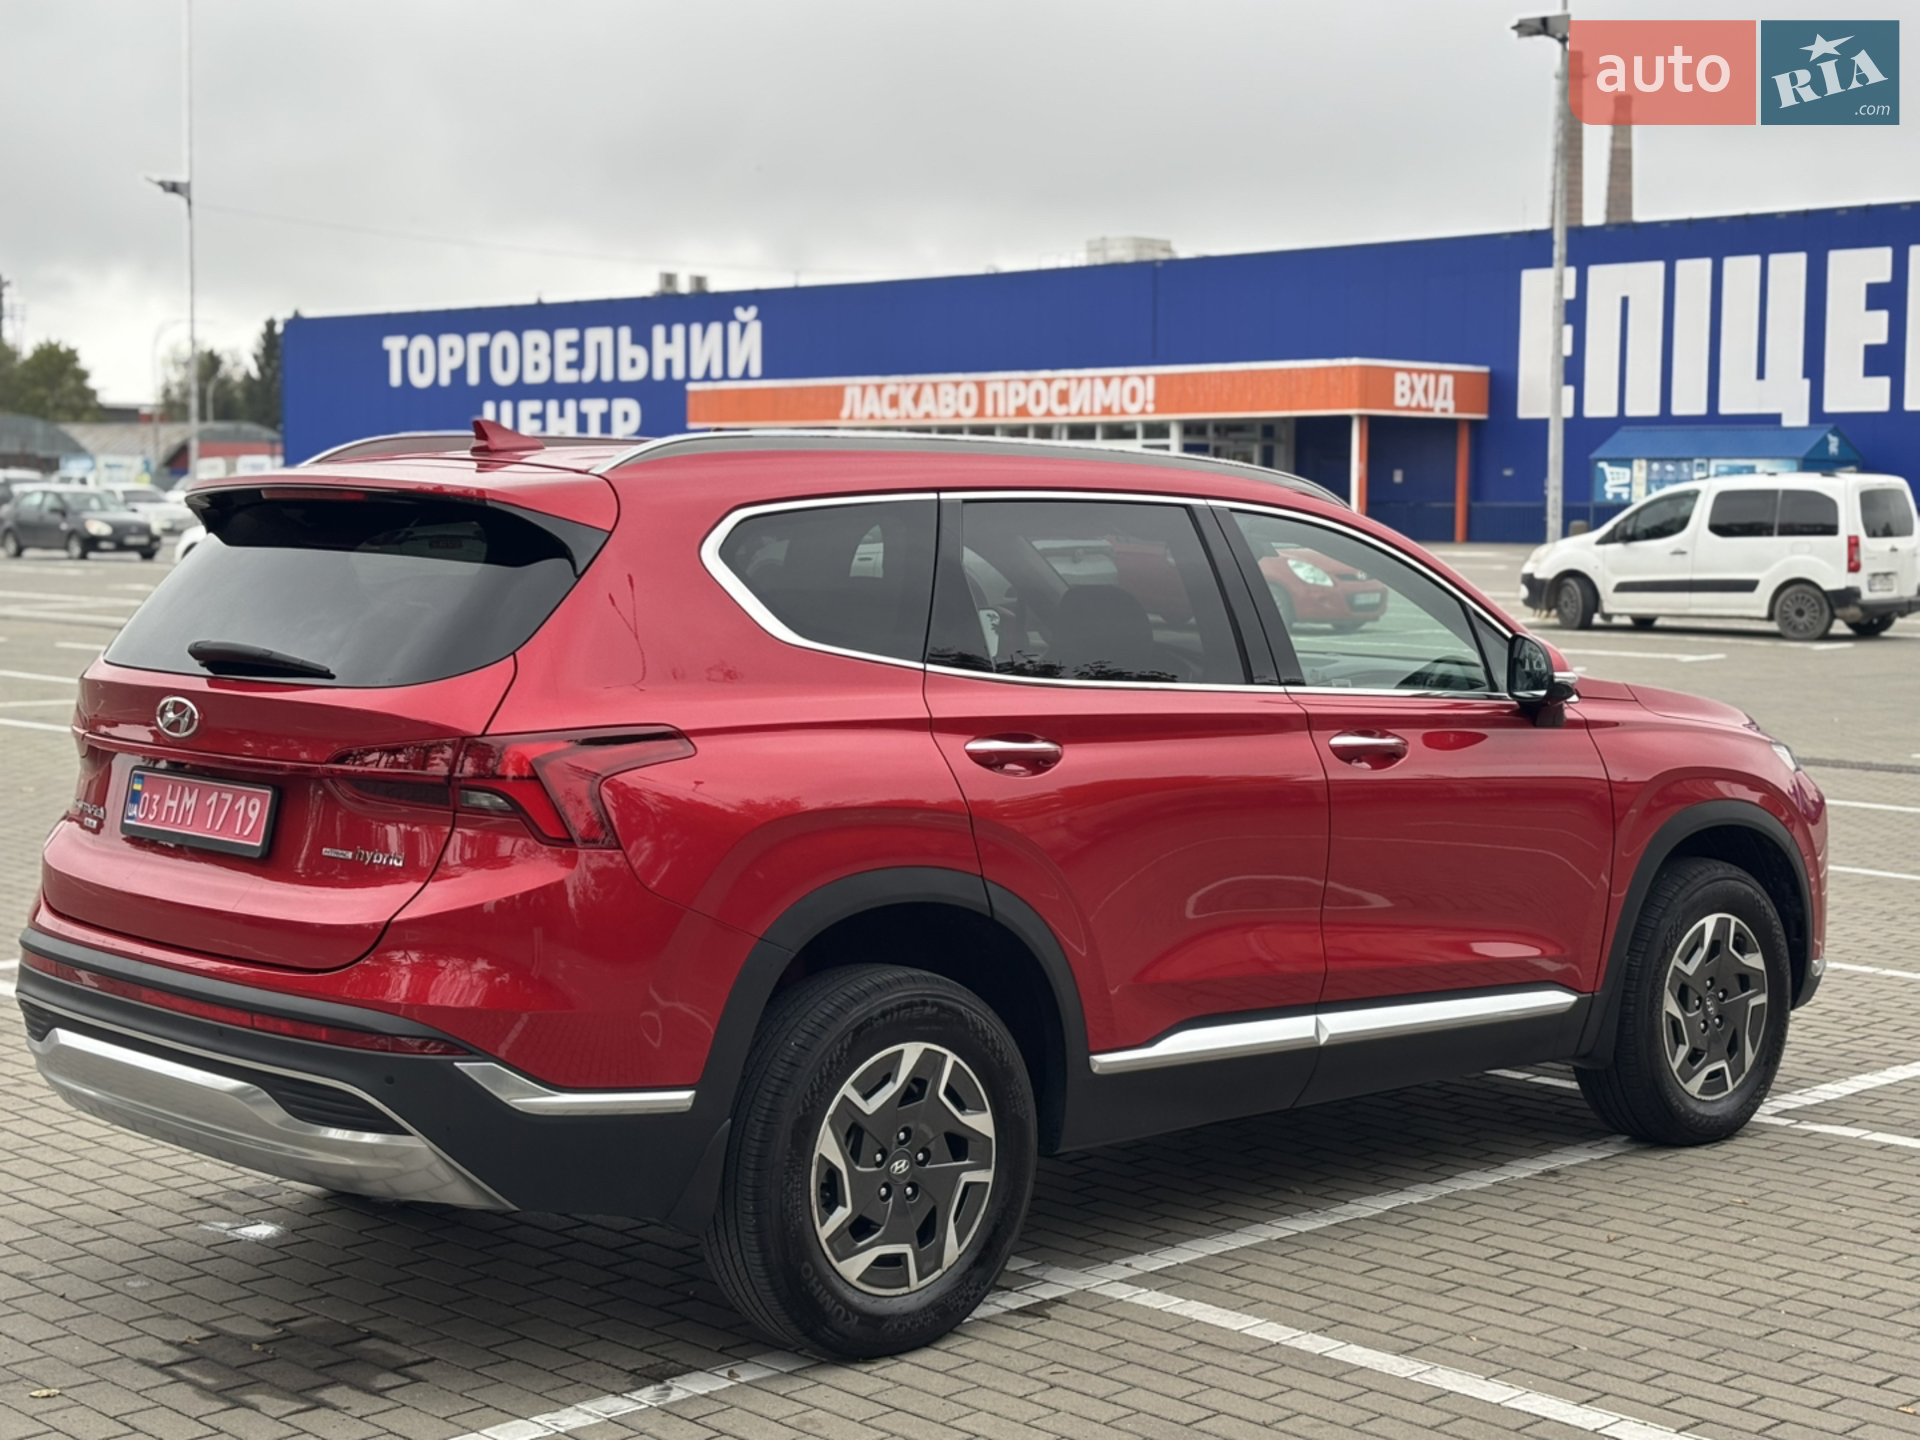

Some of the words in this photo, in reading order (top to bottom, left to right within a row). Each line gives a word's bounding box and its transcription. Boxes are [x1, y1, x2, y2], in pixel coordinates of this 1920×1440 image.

[382, 305, 763, 389] ТОРГОВЕЛЬНИЙ
[1517, 244, 1920, 427] ЕПІЦЕ
[840, 381, 979, 420] ЛАСКАВО
[984, 375, 1156, 417] ПРОСИМО!
[1394, 371, 1455, 413] ВХІД
[138, 792, 161, 821] 03
[205, 791, 262, 837] 1719
[355, 845, 405, 868] hybrid
